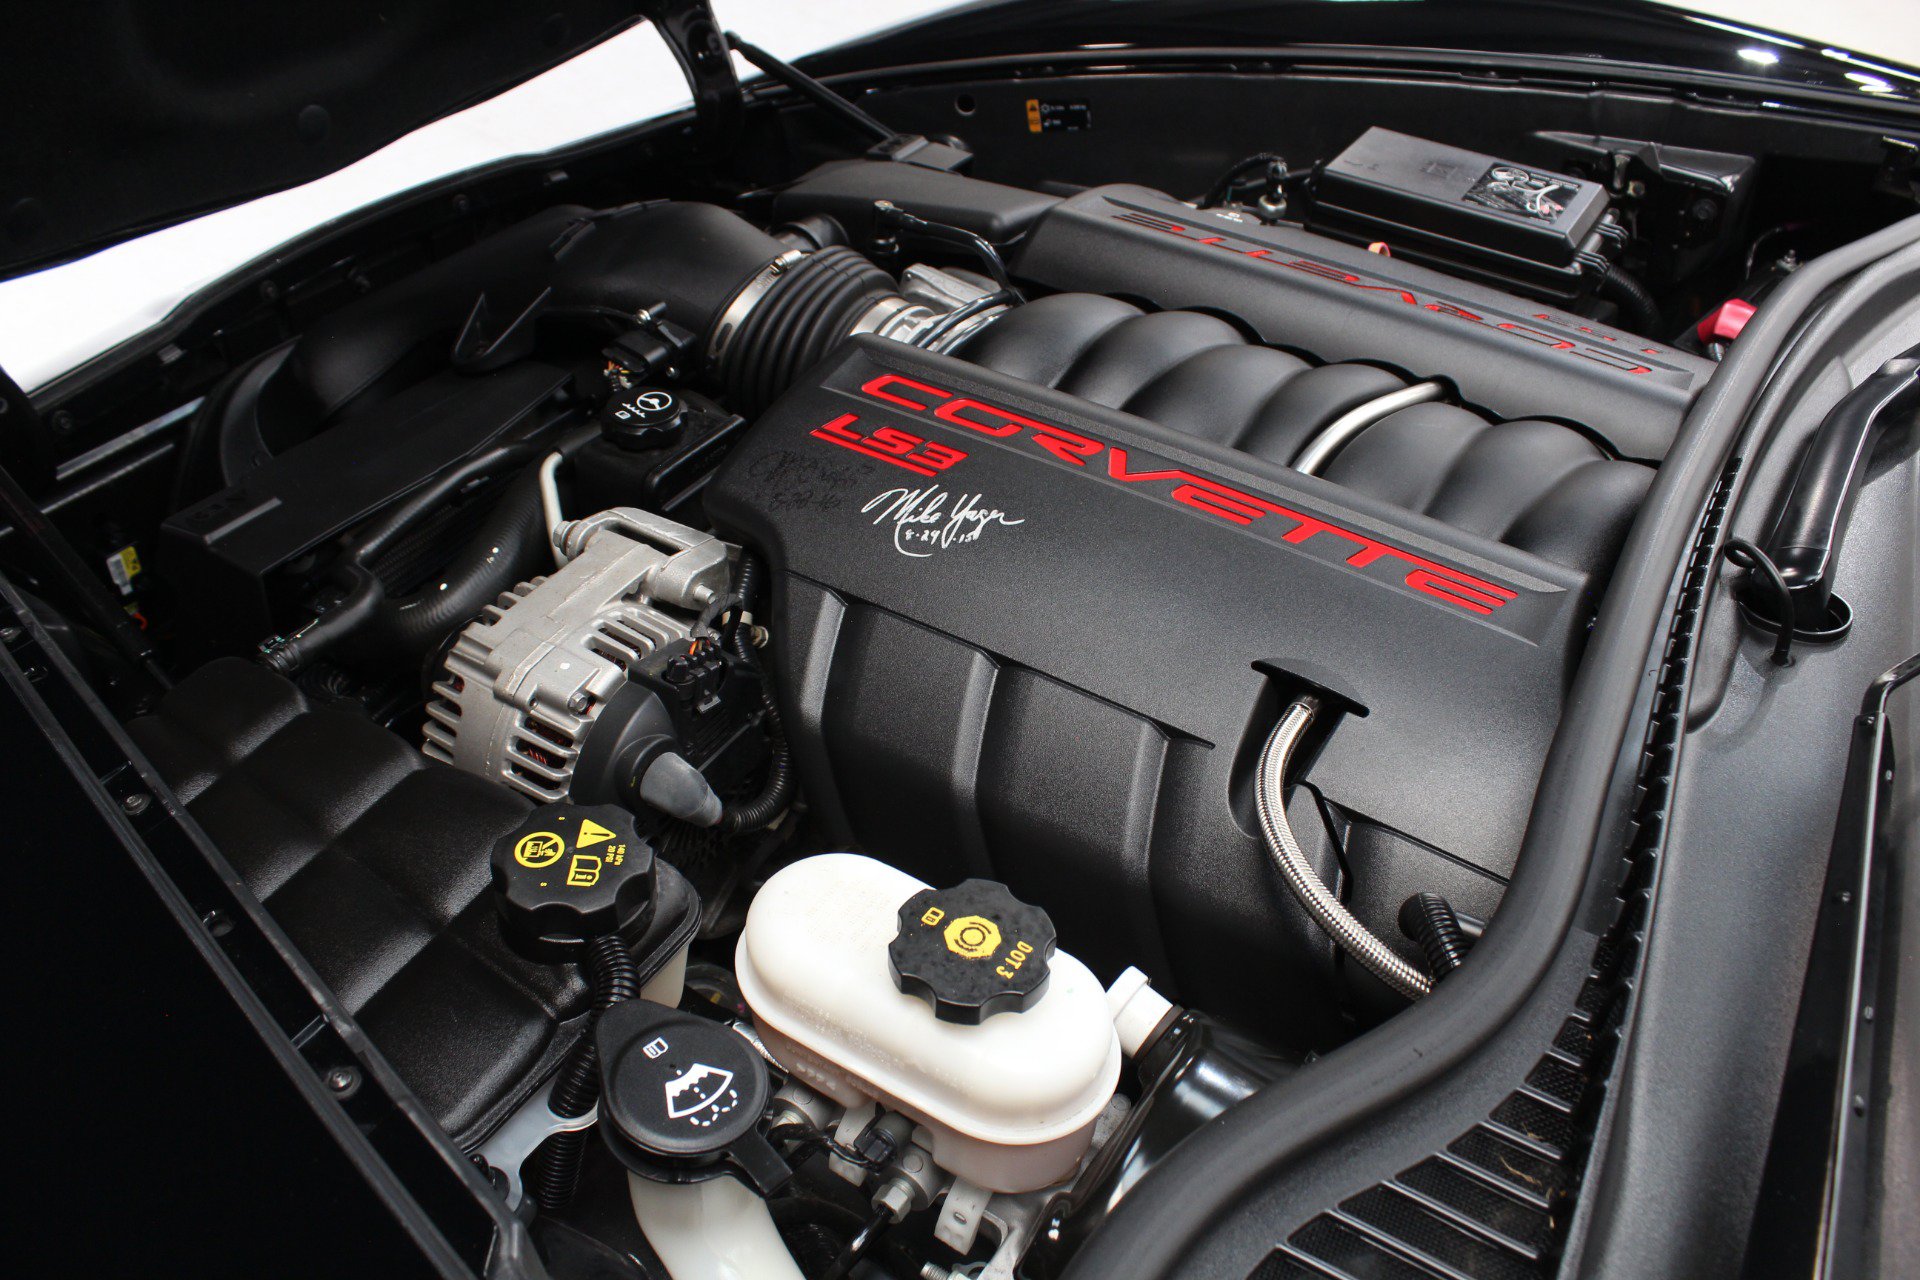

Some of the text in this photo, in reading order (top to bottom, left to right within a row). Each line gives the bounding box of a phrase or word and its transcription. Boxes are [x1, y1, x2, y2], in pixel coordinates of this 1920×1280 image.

[1111, 213, 1654, 375] CORVETTE
[820, 412, 970, 472] LS3
[860, 373, 1519, 616] CORVETTE
[995, 940, 1034, 980] DOT 3
